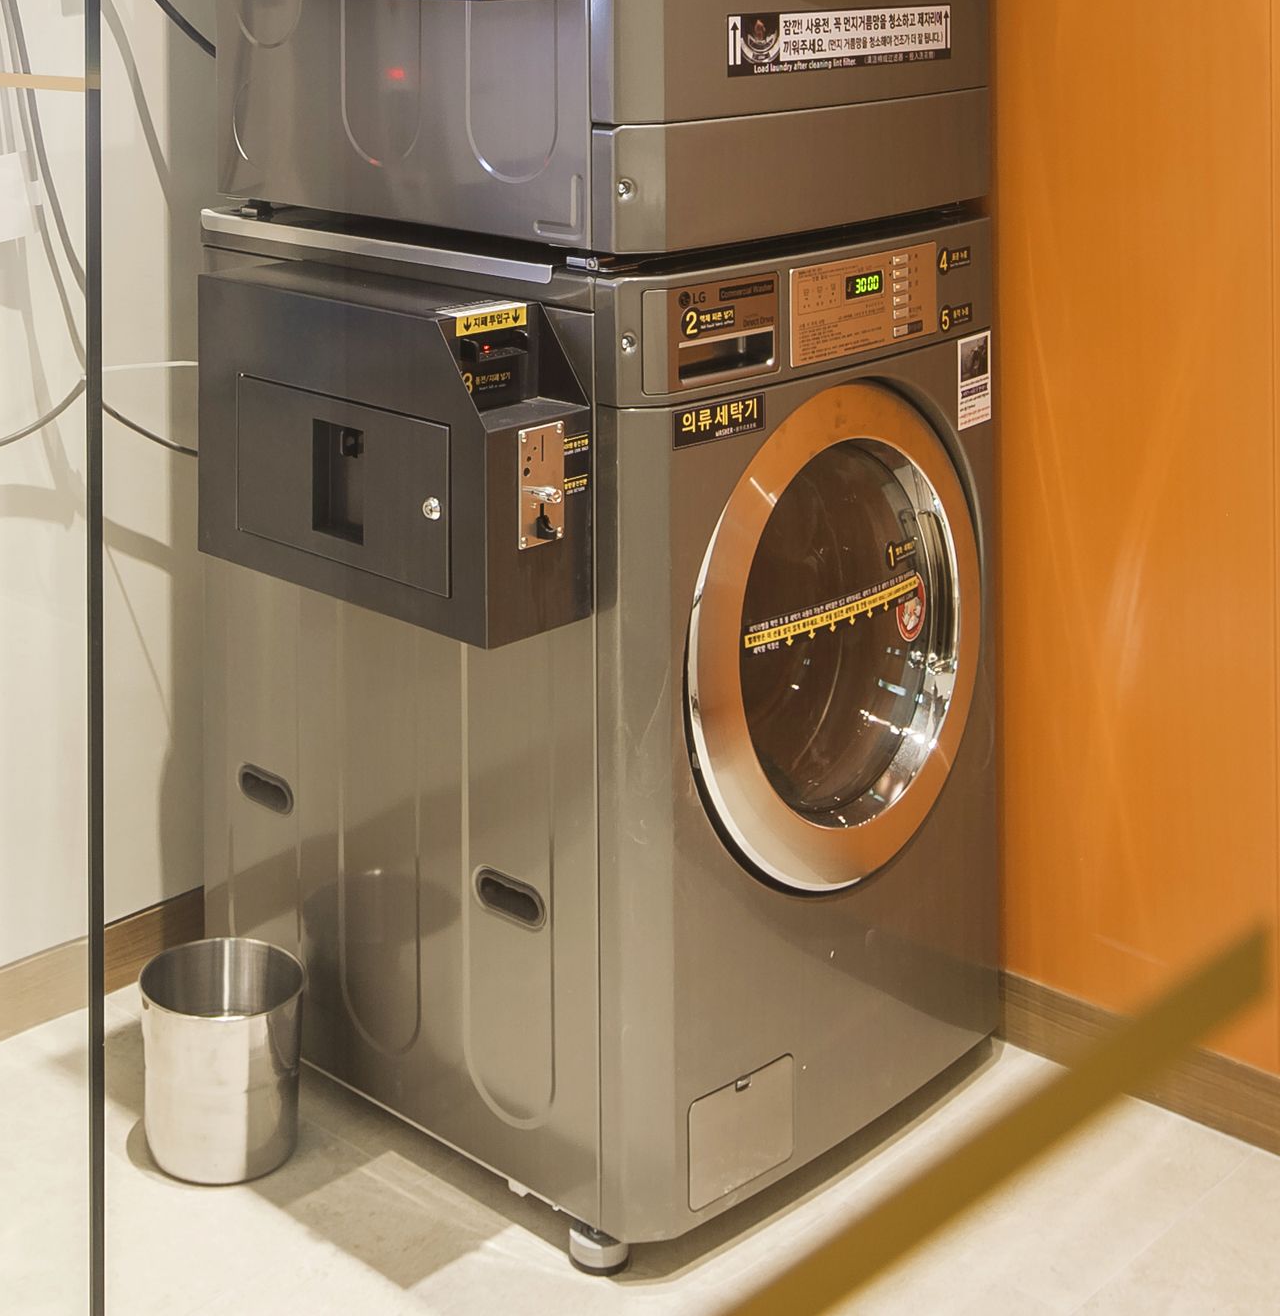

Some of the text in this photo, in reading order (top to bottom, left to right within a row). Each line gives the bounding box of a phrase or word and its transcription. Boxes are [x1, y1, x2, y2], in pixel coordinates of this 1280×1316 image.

[783, 11, 943, 35] 잠깐! 사용전, 꼭 먼지거름망을 청소하고 제자리에
[783, 38, 827, 56] 끼워주세요.
[844, 36, 868, 50] 거름망을
[754, 64, 770, 74] Load
[770, 61, 792, 74] laundry
[793, 60, 808, 71] after
[808, 59, 832, 71] cleaning
[940, 251, 948, 271] 4
[693, 292, 706, 305] LG
[473, 312, 511, 327] 지폐투입구
[686, 311, 698, 335] 2
[743, 316, 759, 328] Direct
[942, 309, 950, 330] 5
[682, 398, 758, 433] 의류세탁기
